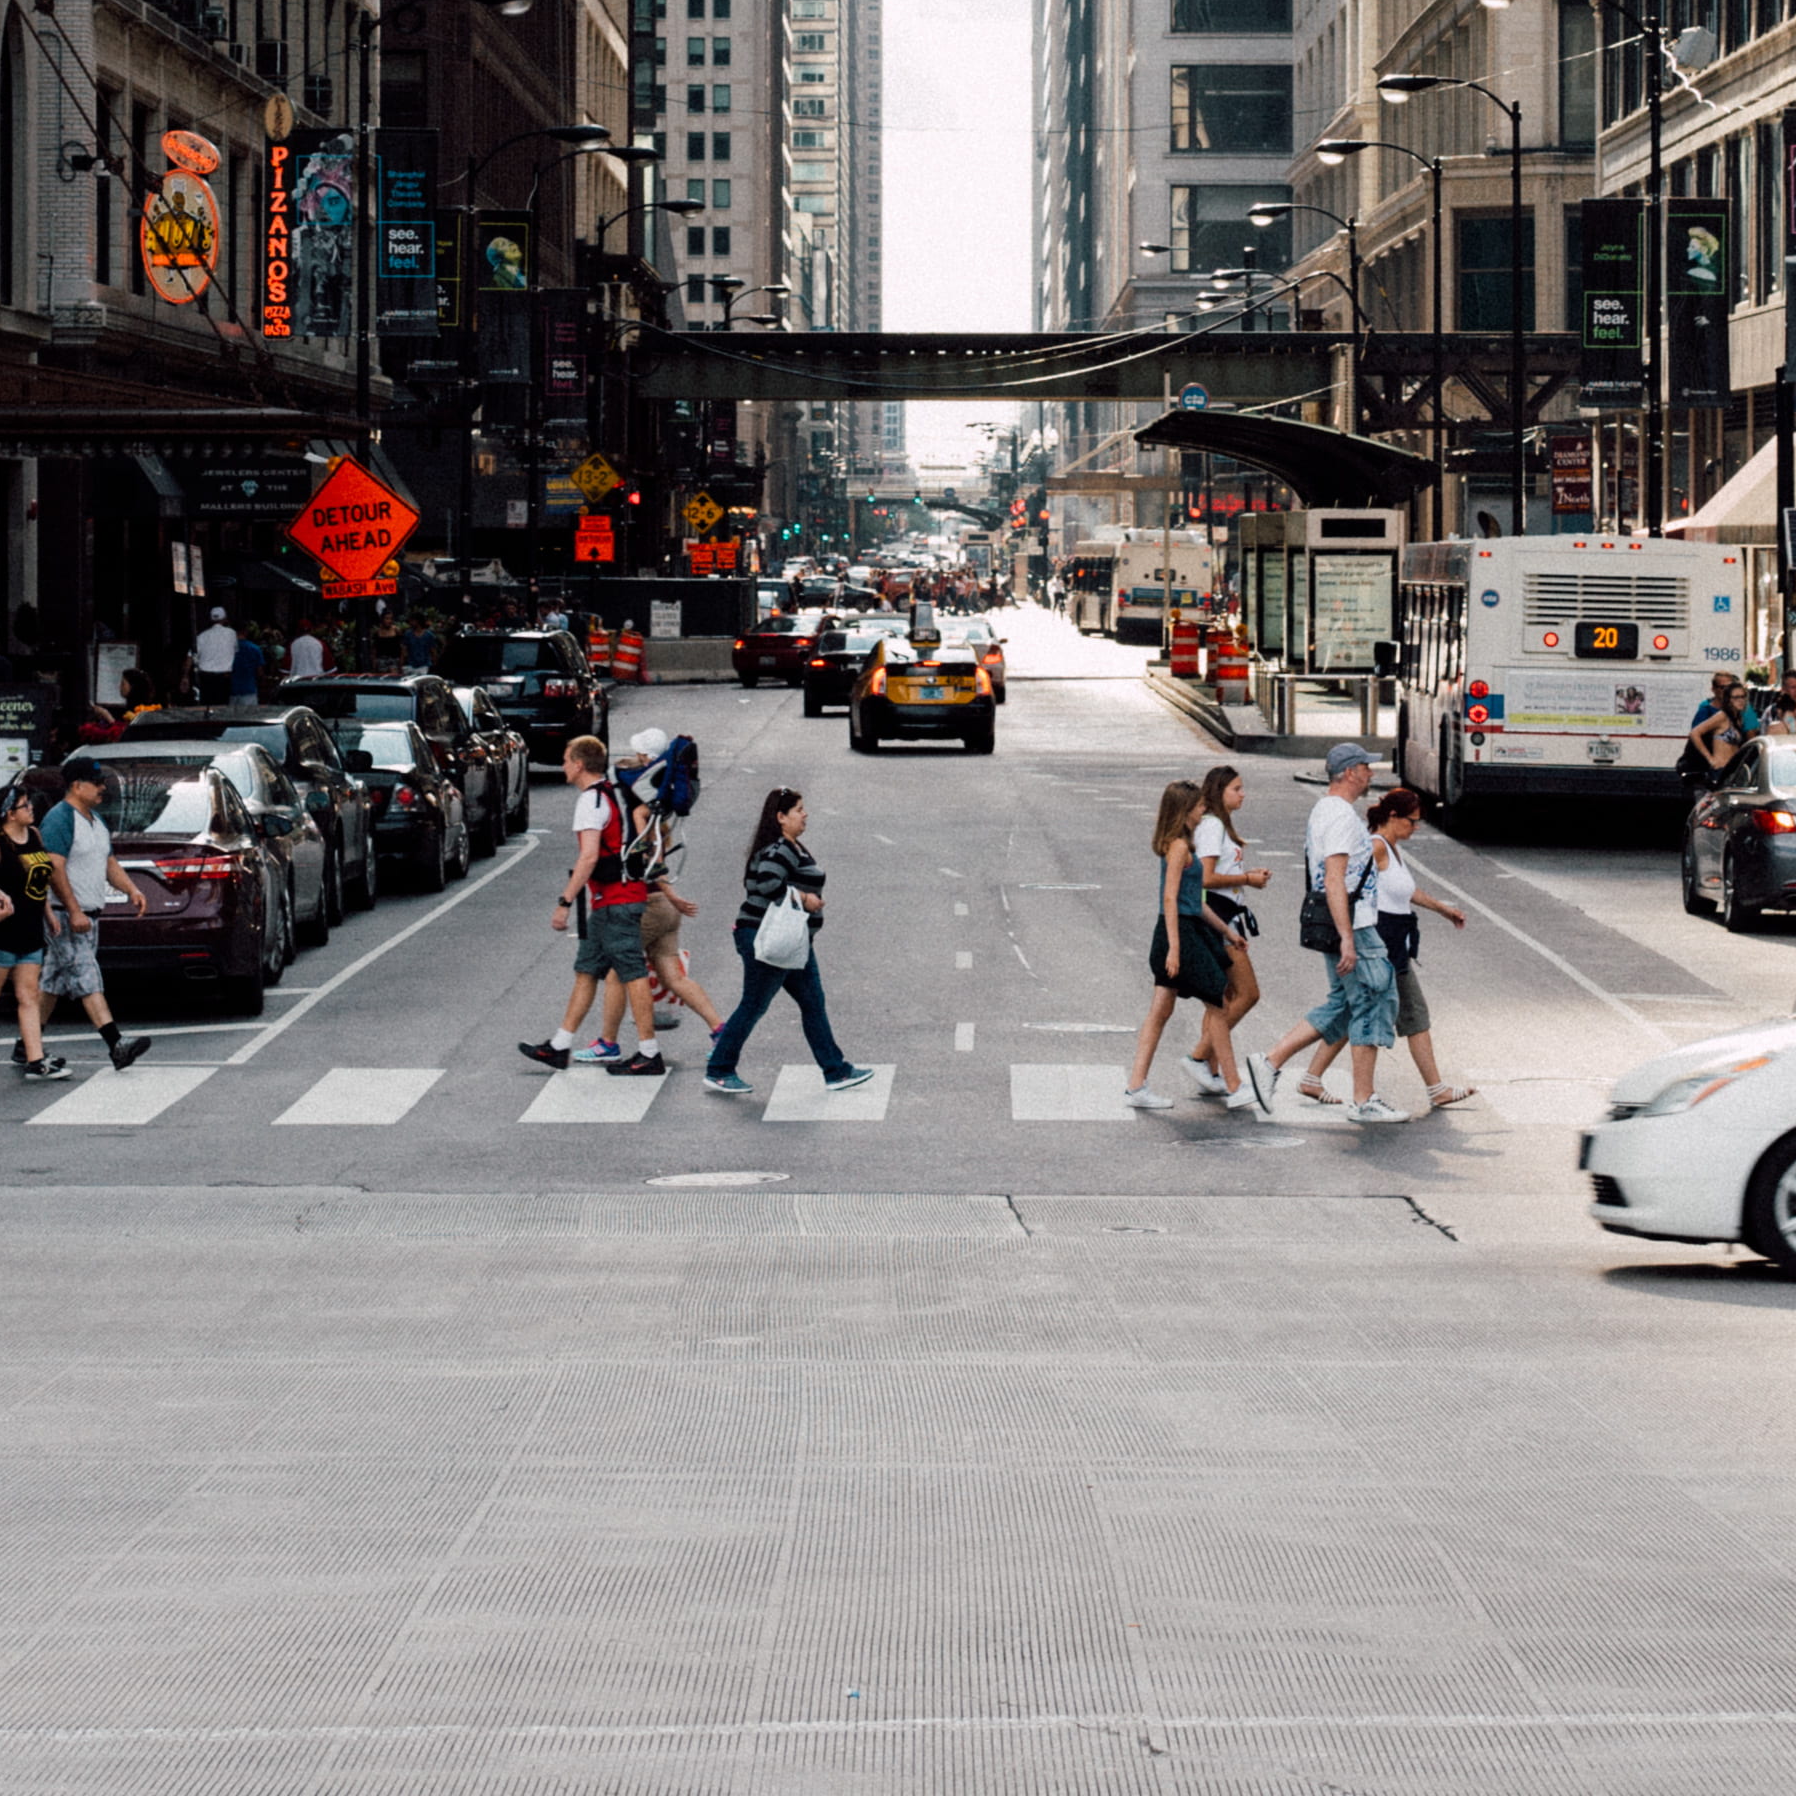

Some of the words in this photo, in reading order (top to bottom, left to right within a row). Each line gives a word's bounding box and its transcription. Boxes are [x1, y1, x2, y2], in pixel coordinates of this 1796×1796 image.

[268, 146, 289, 303] PIZANOS
[388, 229, 419, 240] see.
[388, 240, 424, 254] hear.
[388, 256, 420, 269] feel.
[1593, 299, 1624, 311] see.
[263, 306, 292, 320] PIZZA
[1593, 312, 1630, 325] hear.
[264, 324, 291, 337] PASTA
[1593, 327, 1624, 340] feel.
[552, 360, 575, 368] see.
[552, 369, 578, 379] hear.
[1184, 394, 1204, 405] cta
[1554, 451, 1590, 459] DIAMOND
[1557, 458, 1587, 466] CENTER
[313, 501, 392, 528] DETOUR
[320, 529, 392, 554] AHEAD
[324, 582, 367, 596] WABASH
[375, 581, 395, 593] Ave
[1593, 627, 1619, 649] 20
[1703, 647, 1741, 662] 1986
